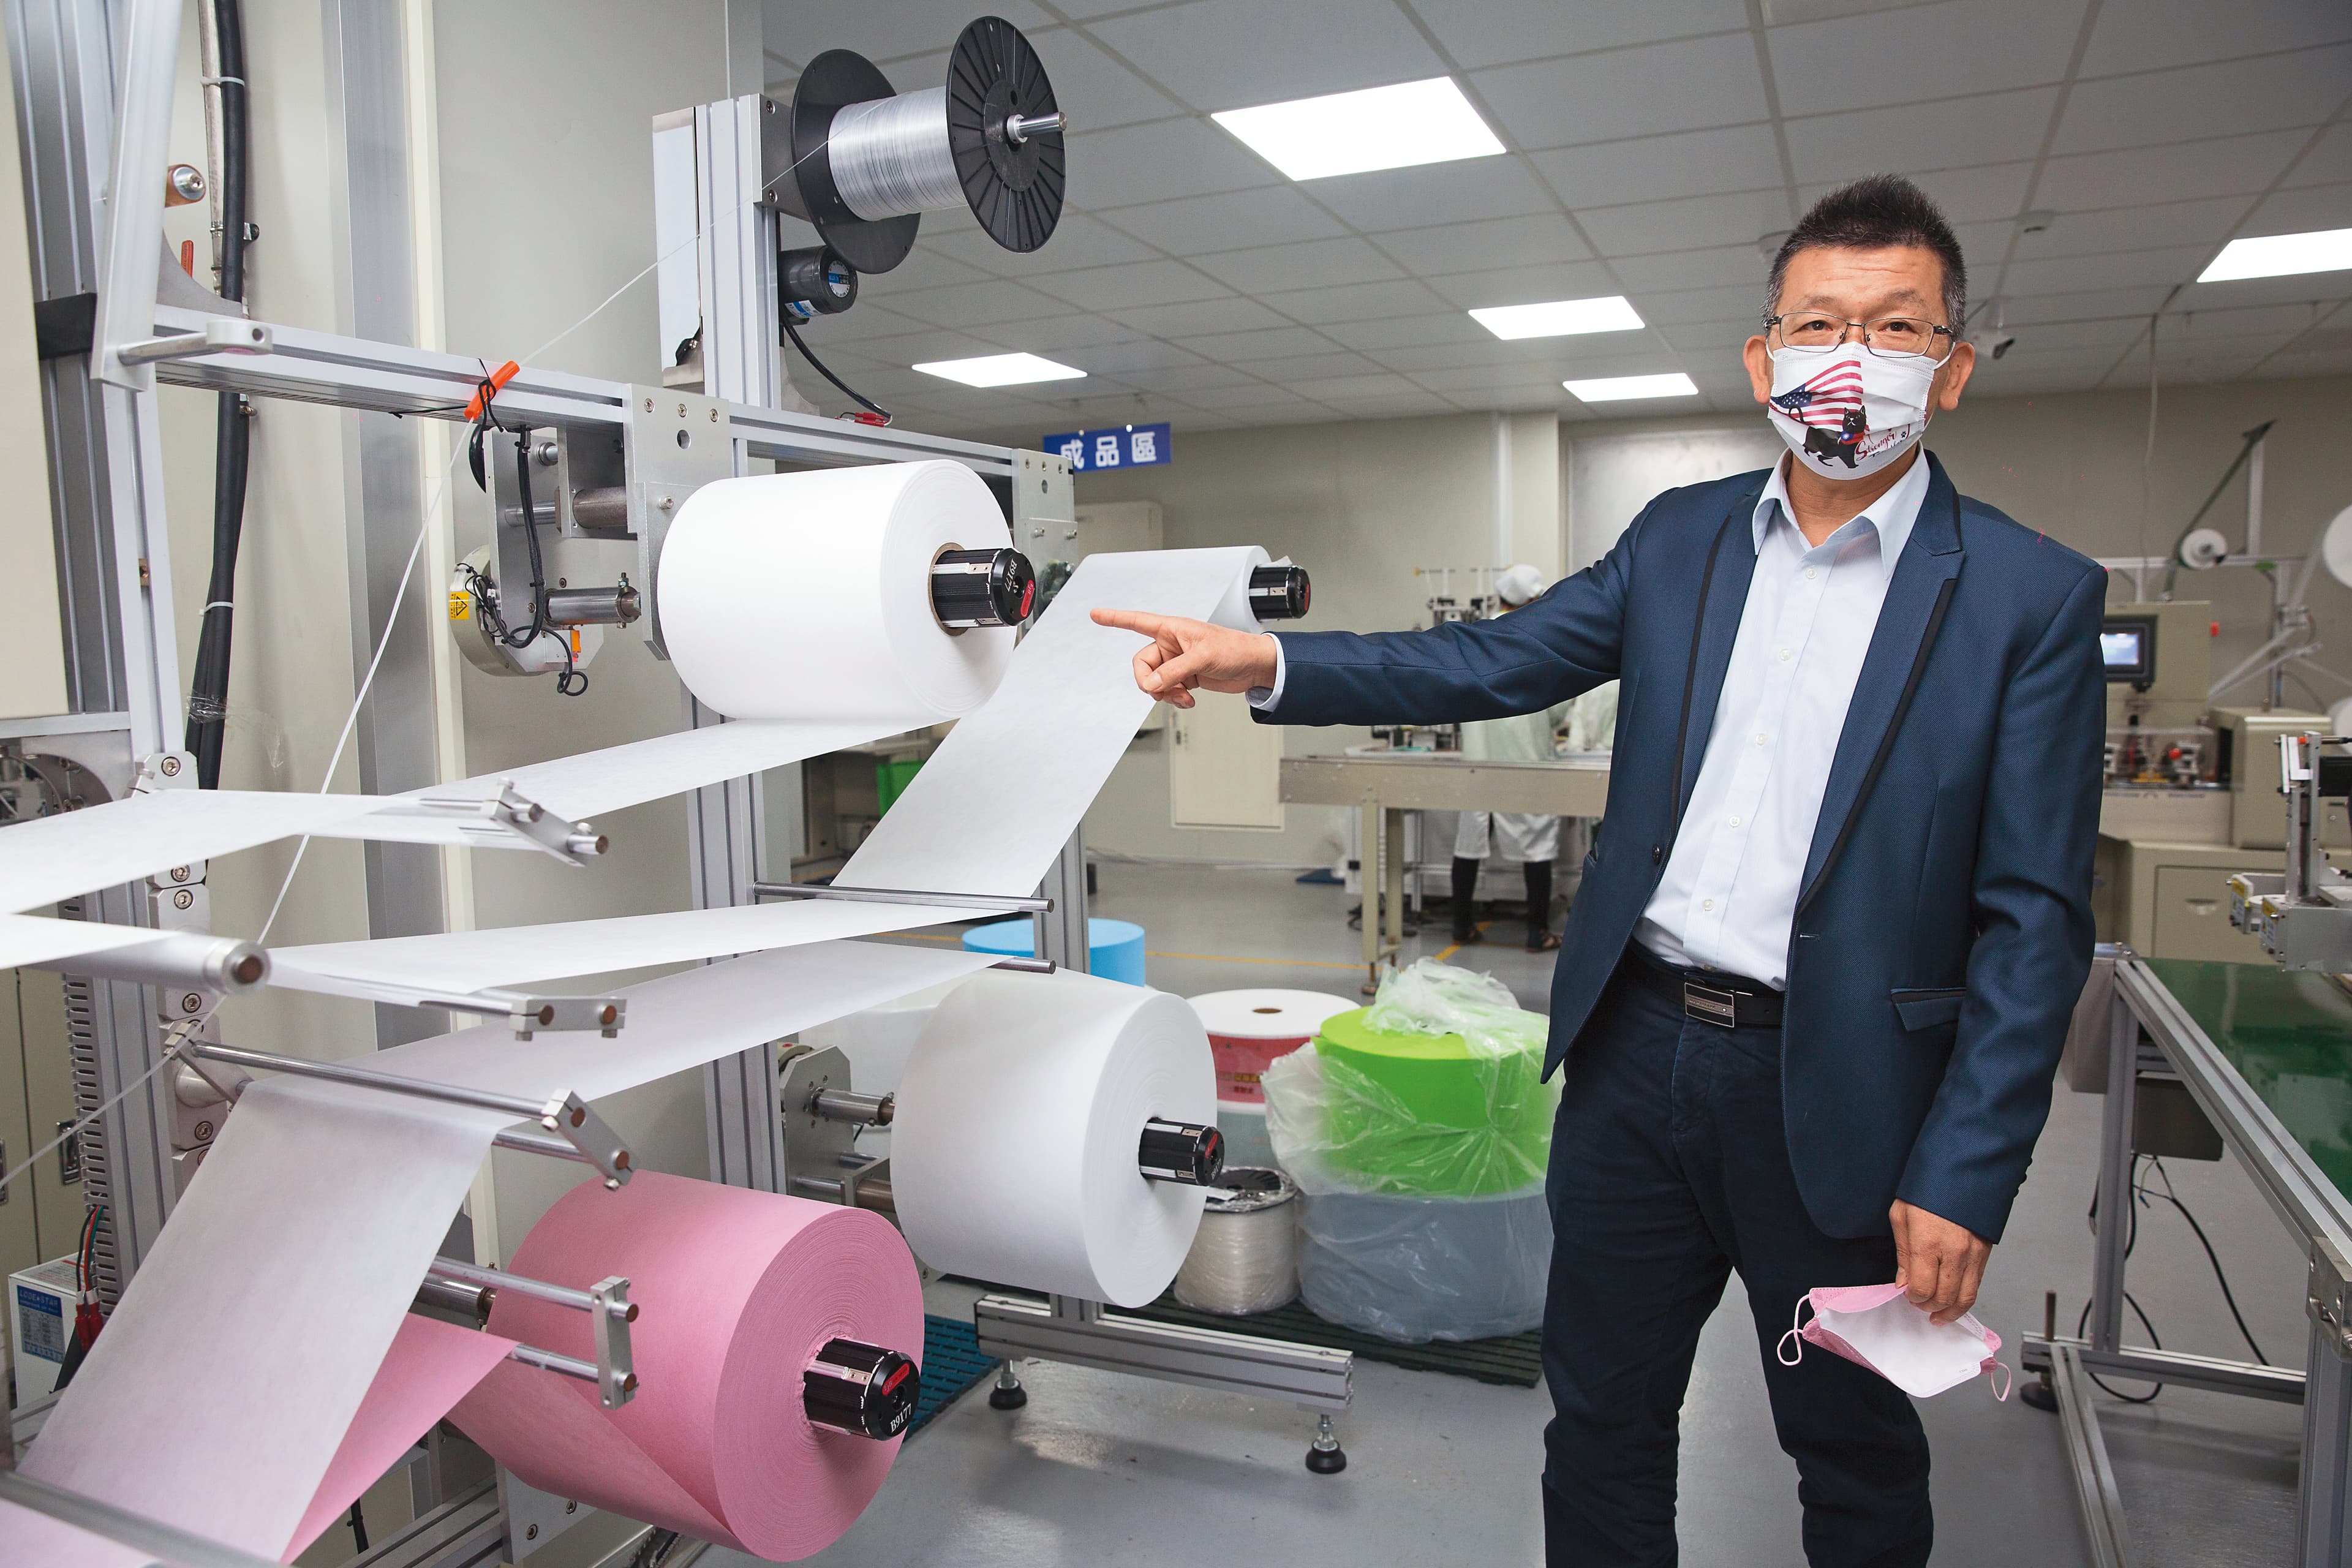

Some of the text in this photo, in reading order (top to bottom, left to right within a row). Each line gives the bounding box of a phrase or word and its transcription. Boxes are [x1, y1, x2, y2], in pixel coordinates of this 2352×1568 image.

[1060, 431, 1157, 469] 成品區
[1005, 559, 1017, 592] B9177
[891, 1403, 911, 1433] B9177
